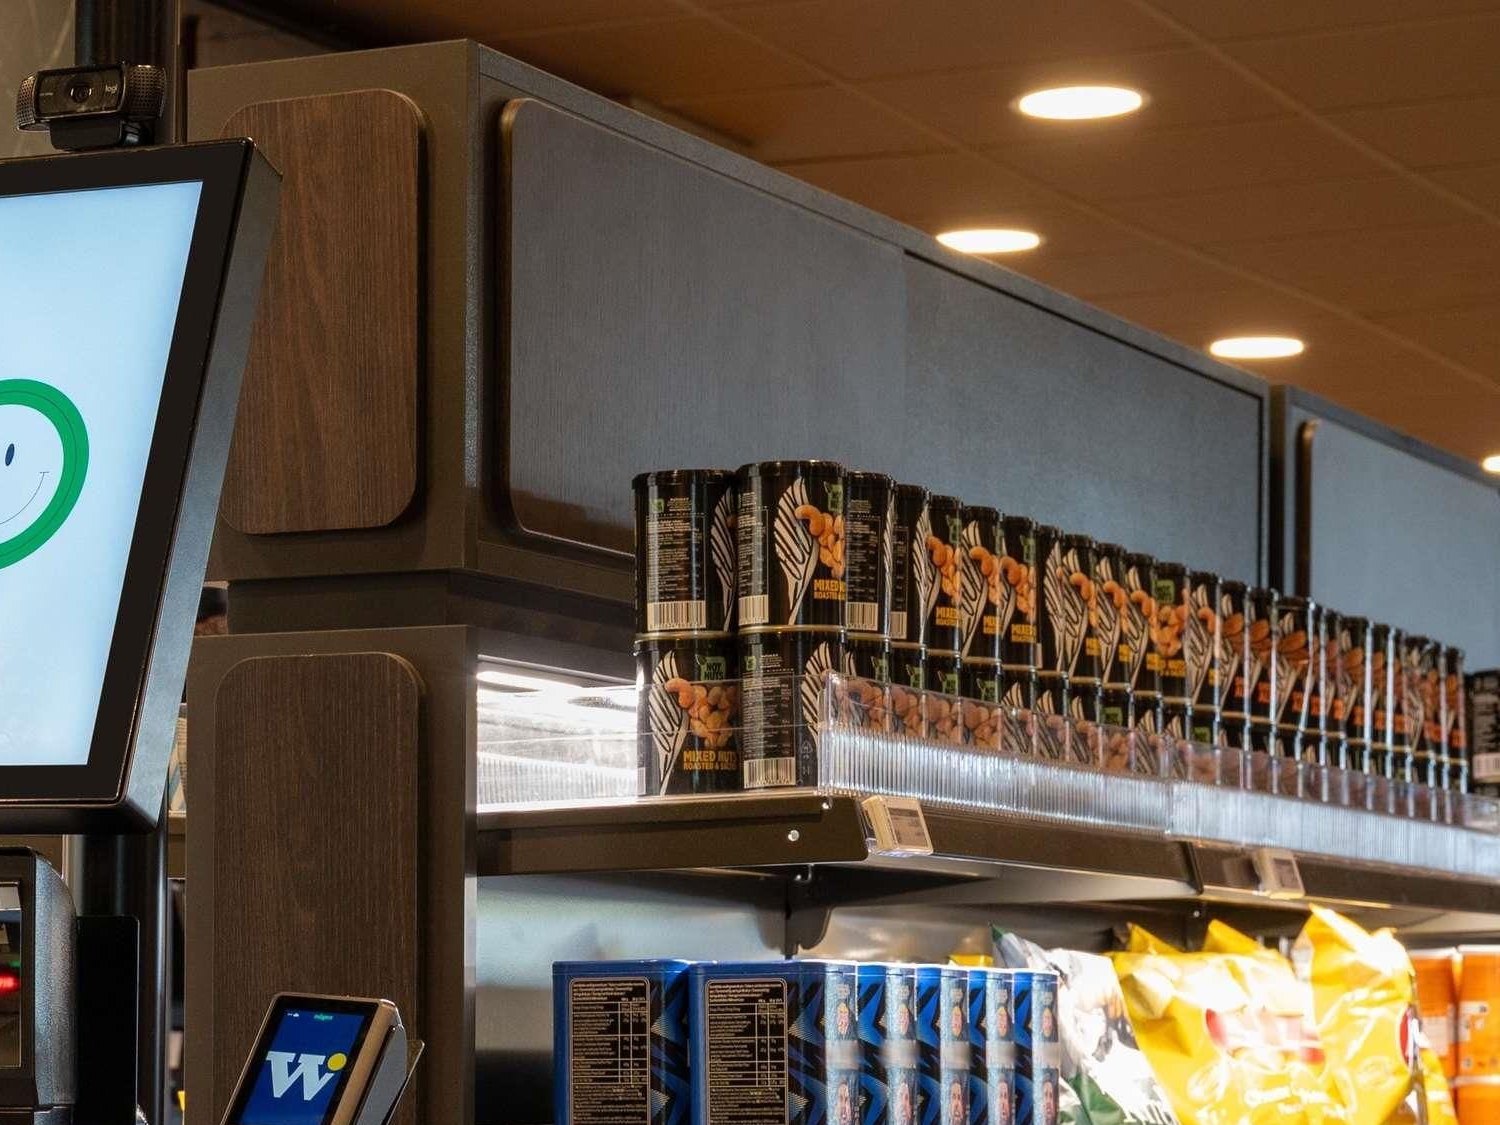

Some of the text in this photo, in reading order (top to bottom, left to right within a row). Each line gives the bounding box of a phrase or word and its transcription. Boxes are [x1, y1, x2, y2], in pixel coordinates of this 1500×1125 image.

[105, 83, 118, 94] logi
[707, 663, 722, 672] NOT
[683, 750, 716, 762] MIXED
[266, 1051, 335, 1101] W
